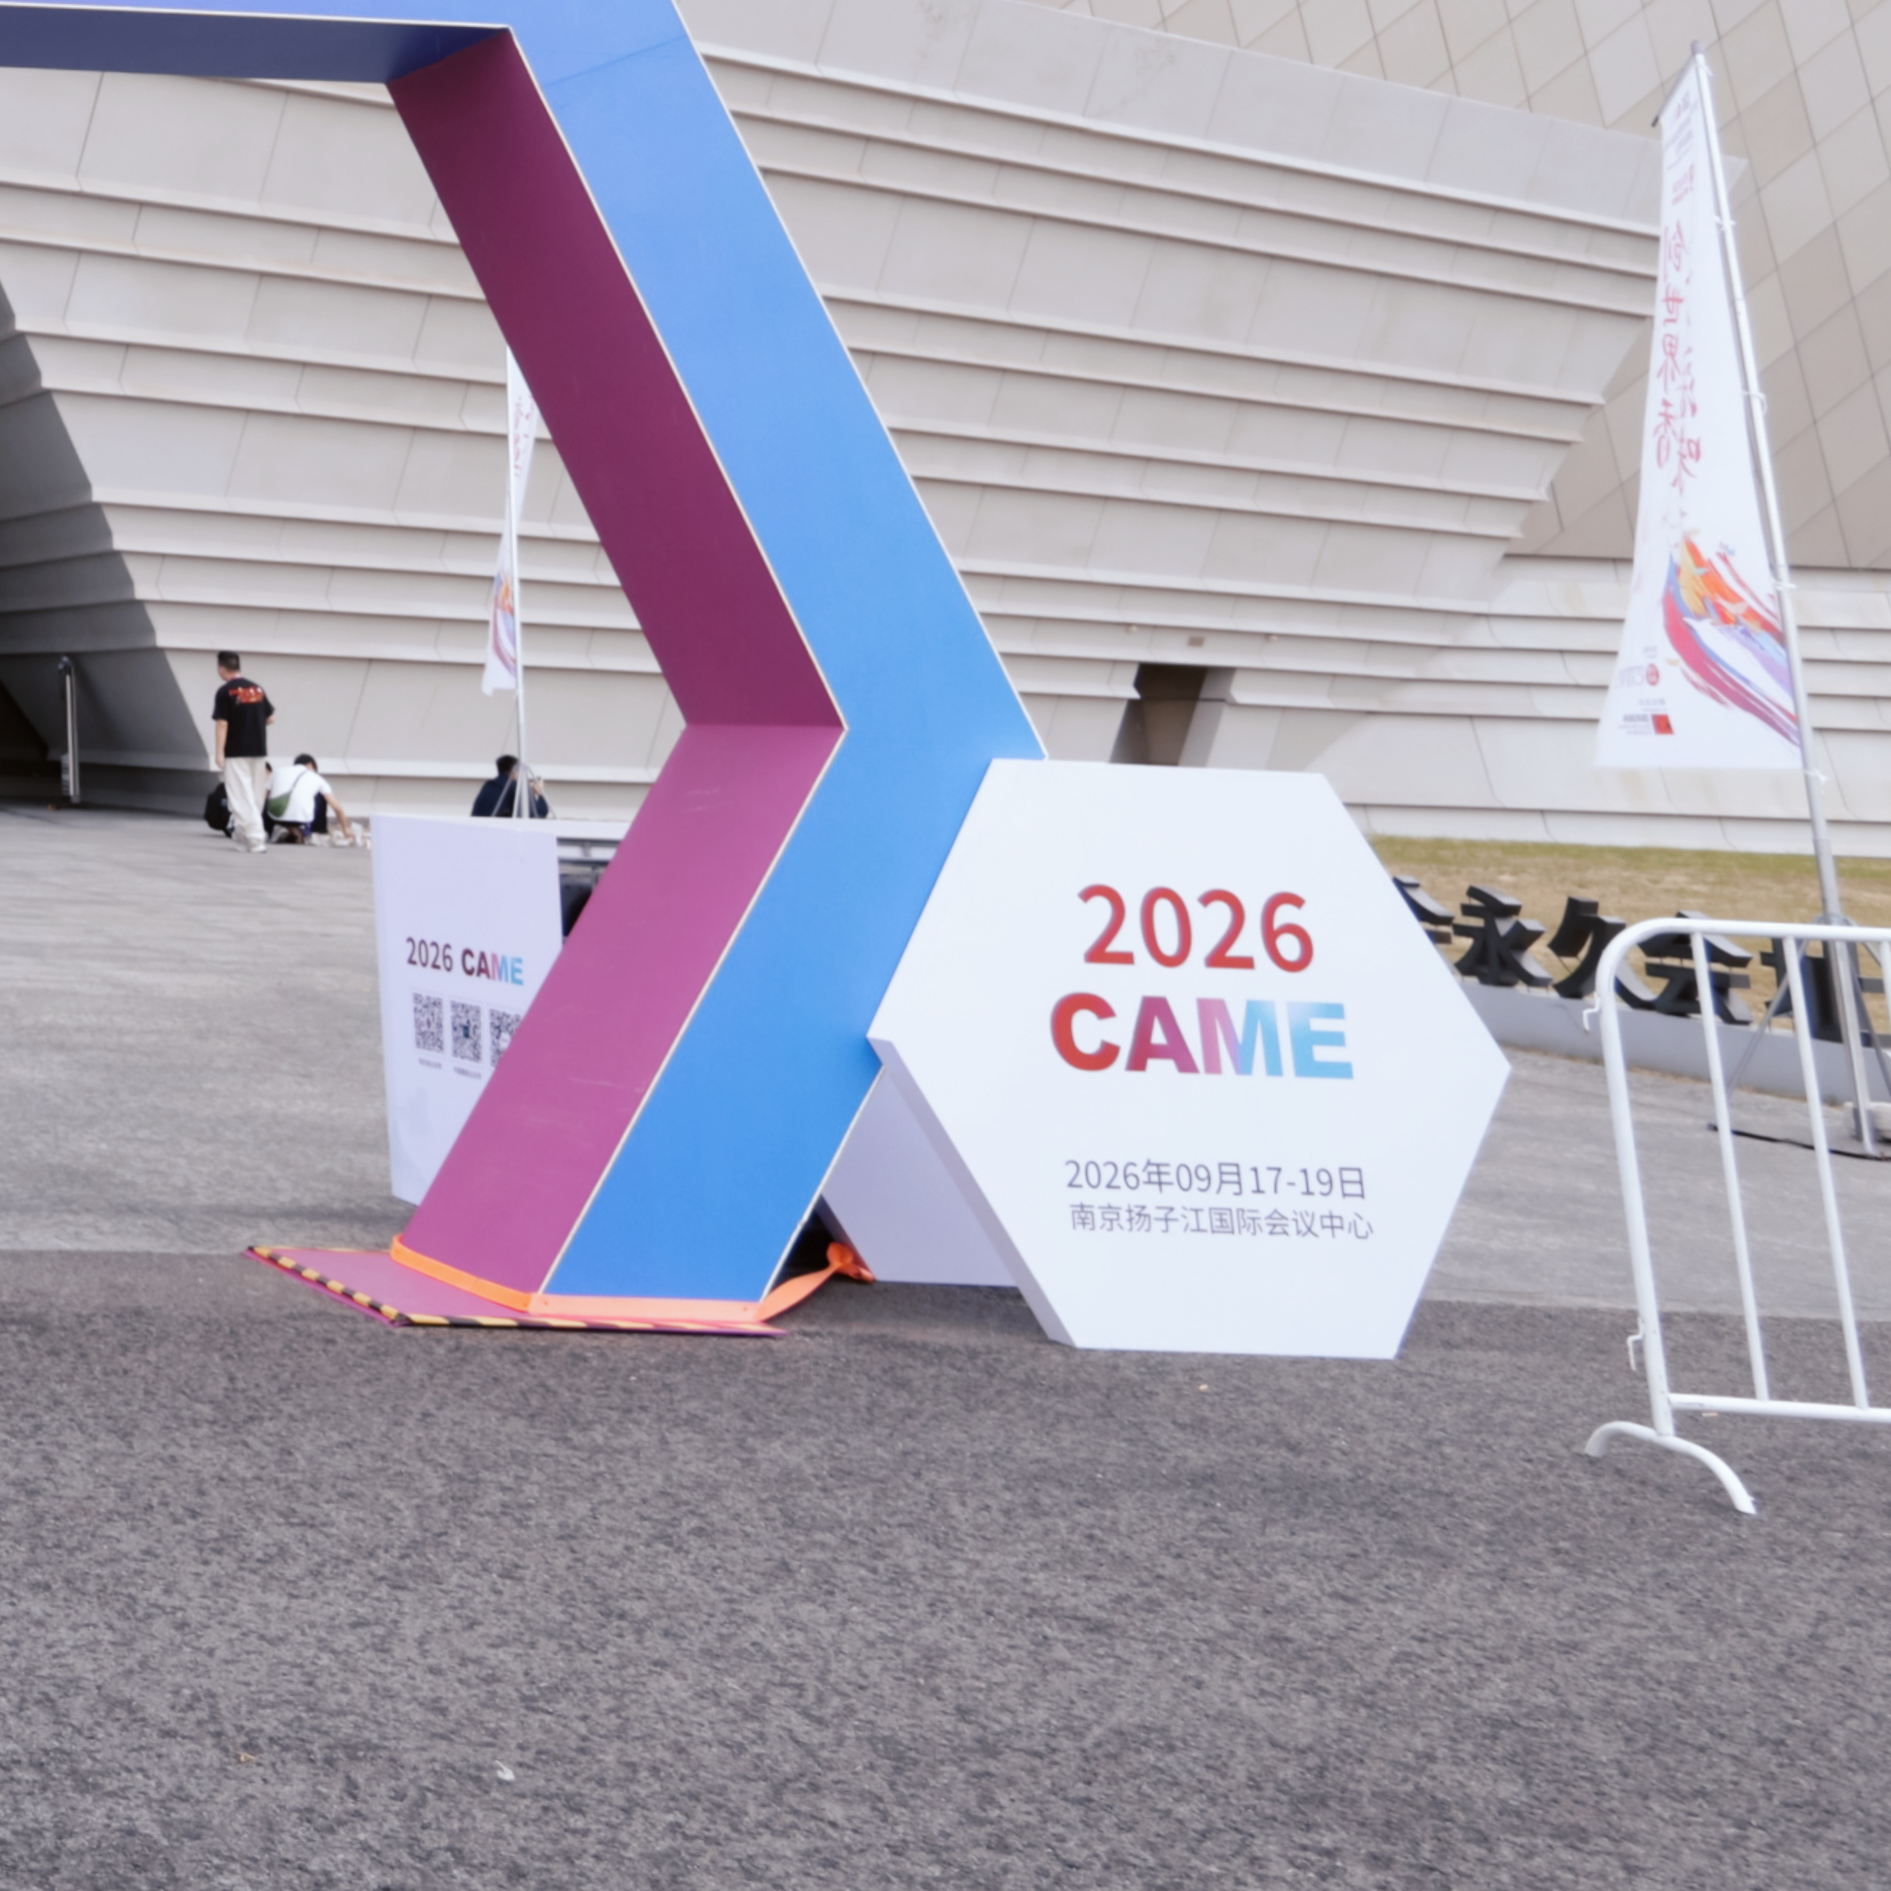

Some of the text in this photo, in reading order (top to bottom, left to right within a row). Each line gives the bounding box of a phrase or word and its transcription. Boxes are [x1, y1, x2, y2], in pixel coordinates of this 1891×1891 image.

[1077, 882, 1314, 973] 2026
[406, 936, 525, 987] 2026 CAME
[1050, 991, 1354, 1080] CAME
[1064, 1158, 1366, 1201] 2026年09月17-19日
[1068, 1202, 1375, 1241] 南京扬子江国际会议中心
